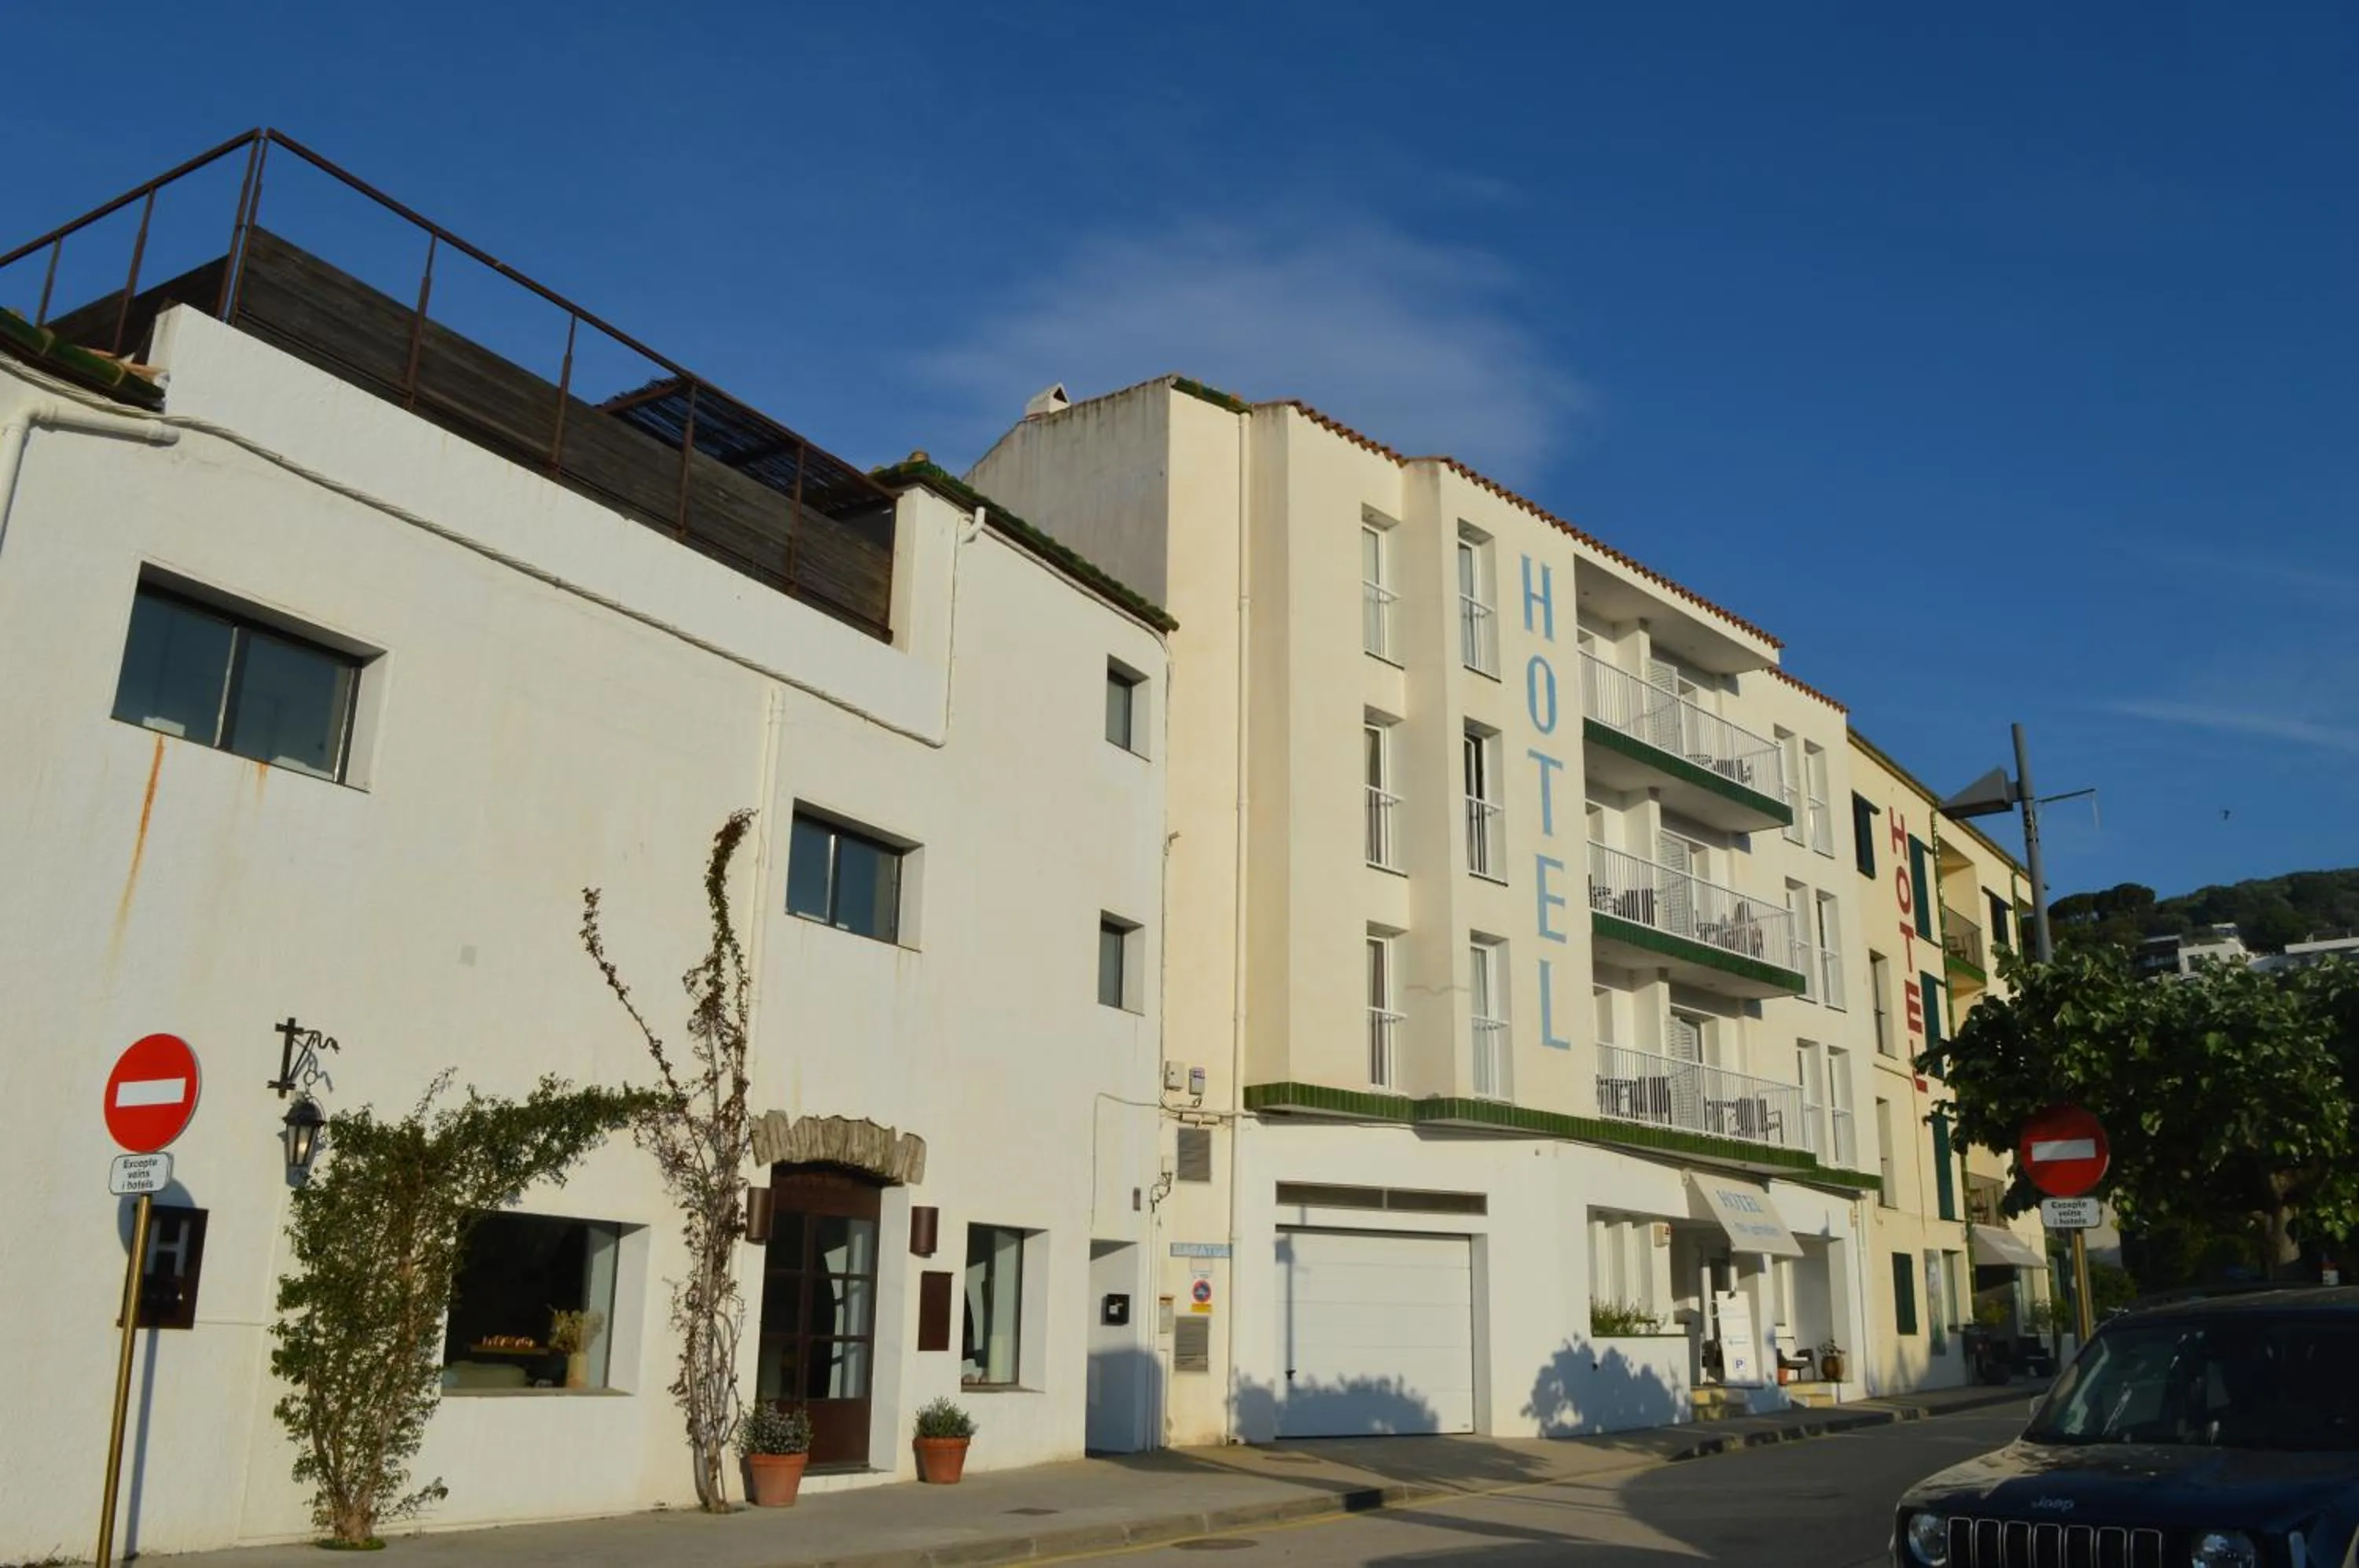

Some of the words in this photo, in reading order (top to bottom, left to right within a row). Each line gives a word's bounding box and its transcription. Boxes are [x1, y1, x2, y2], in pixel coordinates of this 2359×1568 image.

[1521, 554, 1571, 1051] HOTEL
[1889, 805, 1929, 1094] HOTEL
[123, 1158, 158, 1169] Excepte
[127, 1180, 154, 1190] hotels
[1716, 1189, 1764, 1213] HOTEL
[145, 1217, 190, 1278] H
[2031, 1495, 2074, 1513] Jeep
